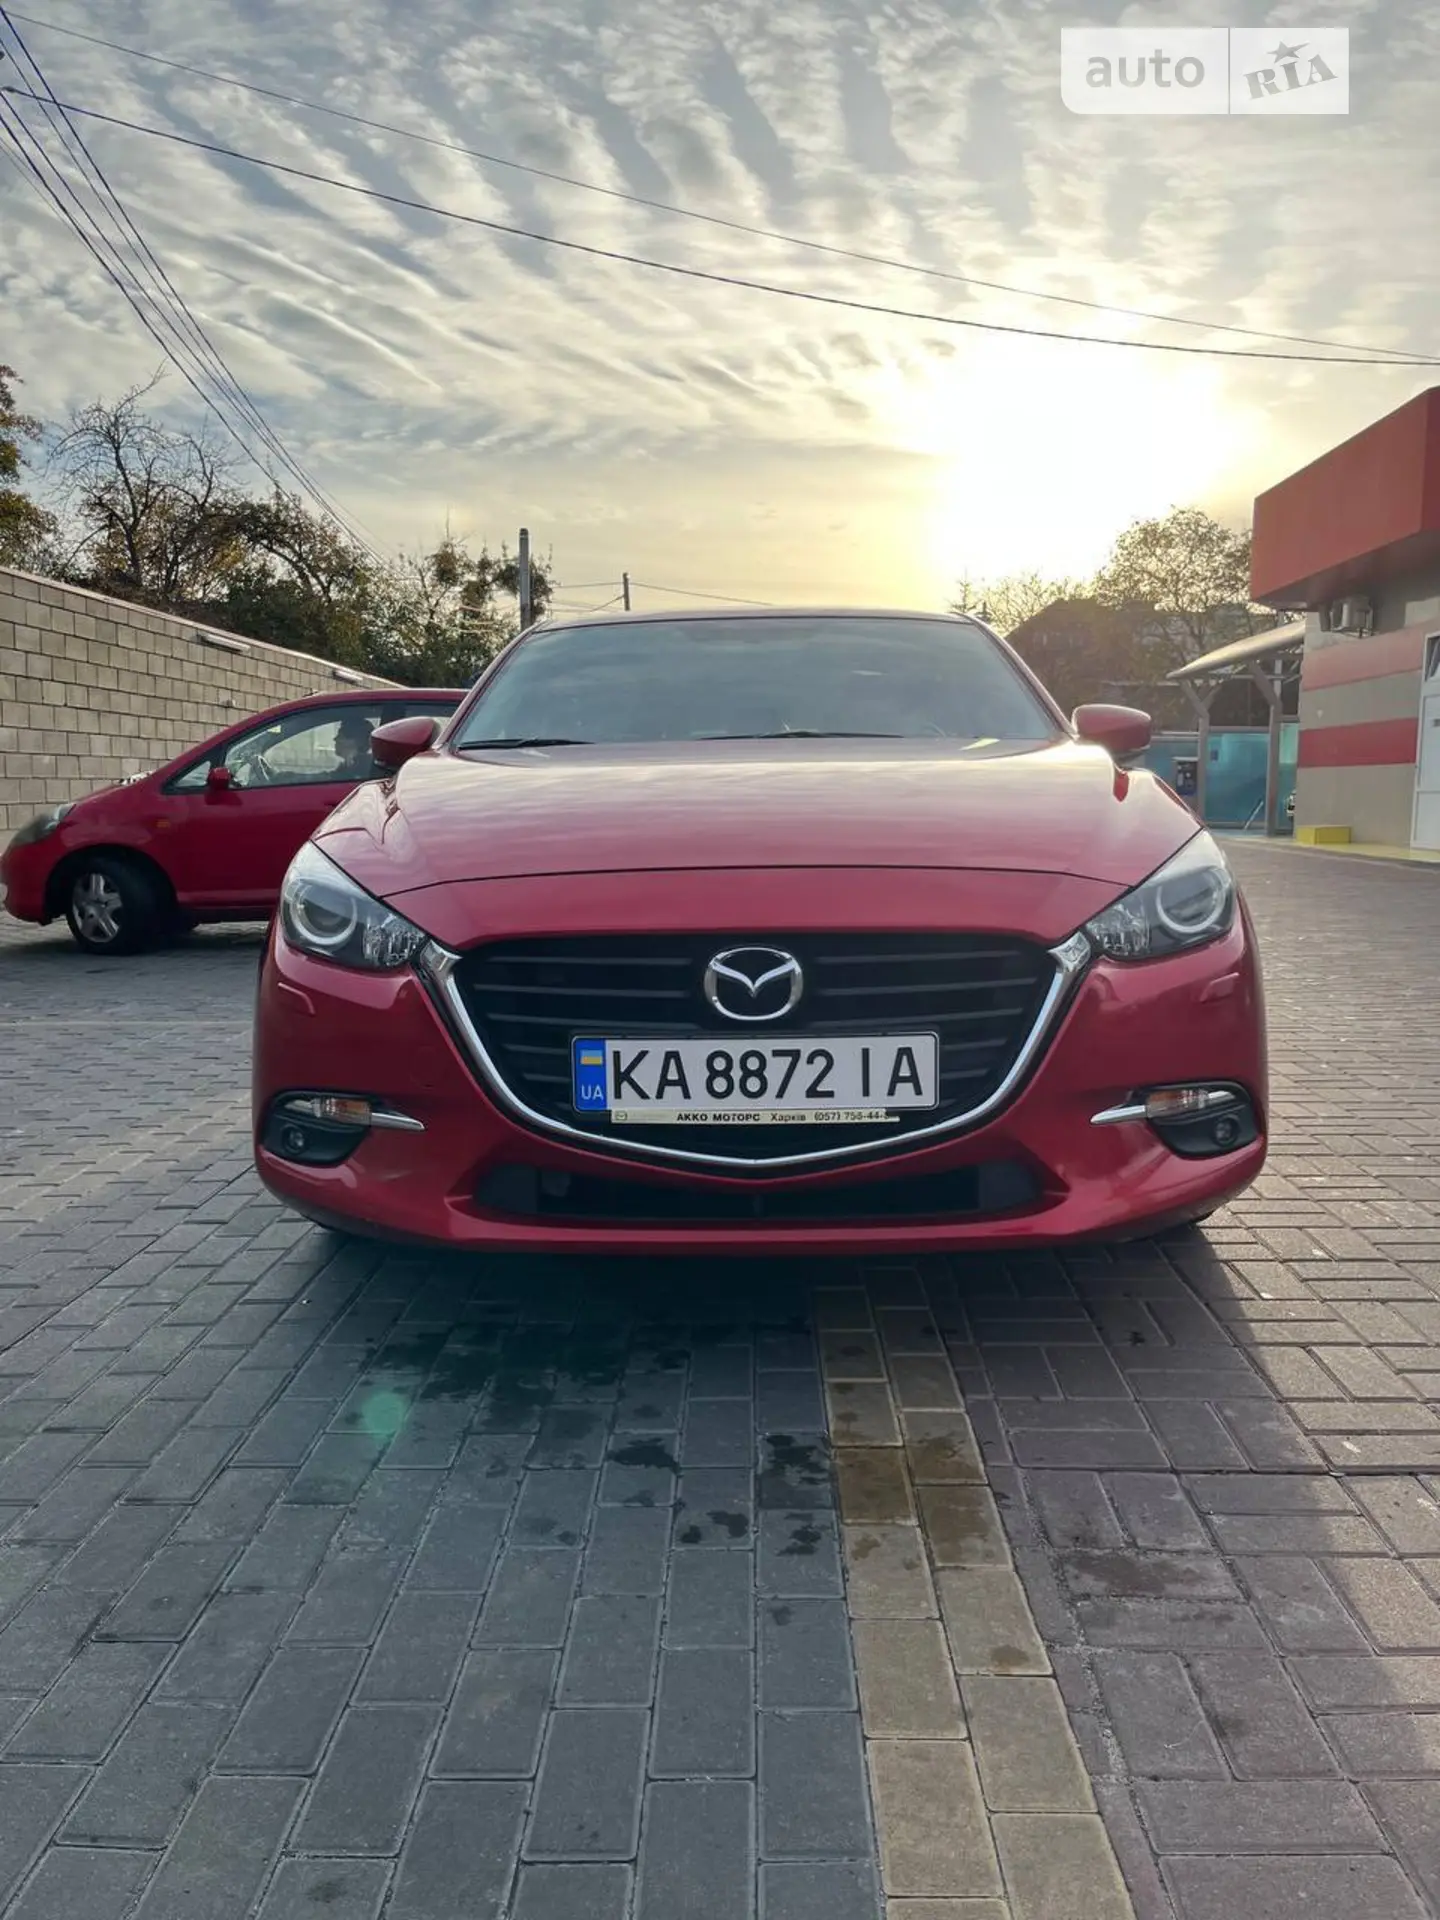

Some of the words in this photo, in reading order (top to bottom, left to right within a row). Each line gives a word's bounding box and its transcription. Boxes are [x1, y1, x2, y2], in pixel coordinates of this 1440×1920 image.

[612, 1049, 692, 1100] KA
[705, 1048, 835, 1099] 8872
[861, 1046, 923, 1097] IA
[580, 1085, 604, 1102] UA
